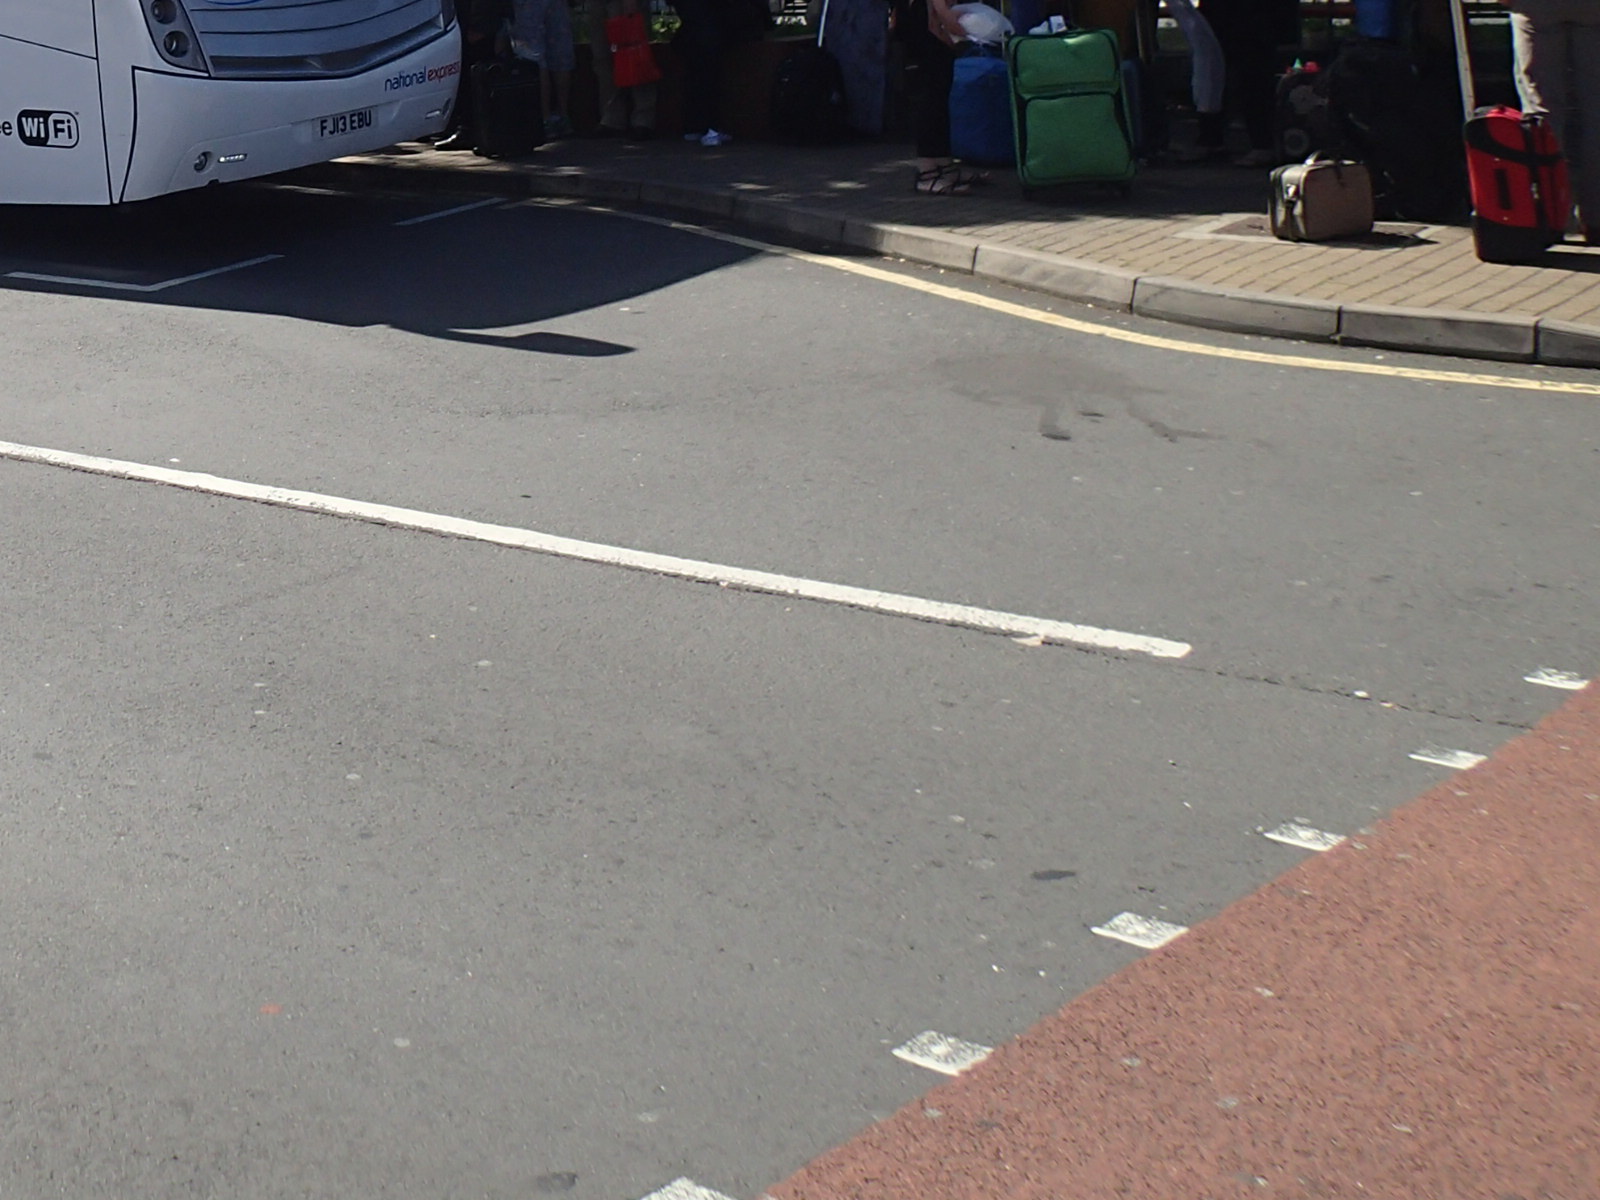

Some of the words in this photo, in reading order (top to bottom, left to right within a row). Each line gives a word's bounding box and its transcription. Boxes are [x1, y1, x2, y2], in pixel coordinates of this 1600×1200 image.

[384, 66, 427, 93] national
[320, 115, 347, 138] FJ13
[349, 110, 373, 131] EBU
